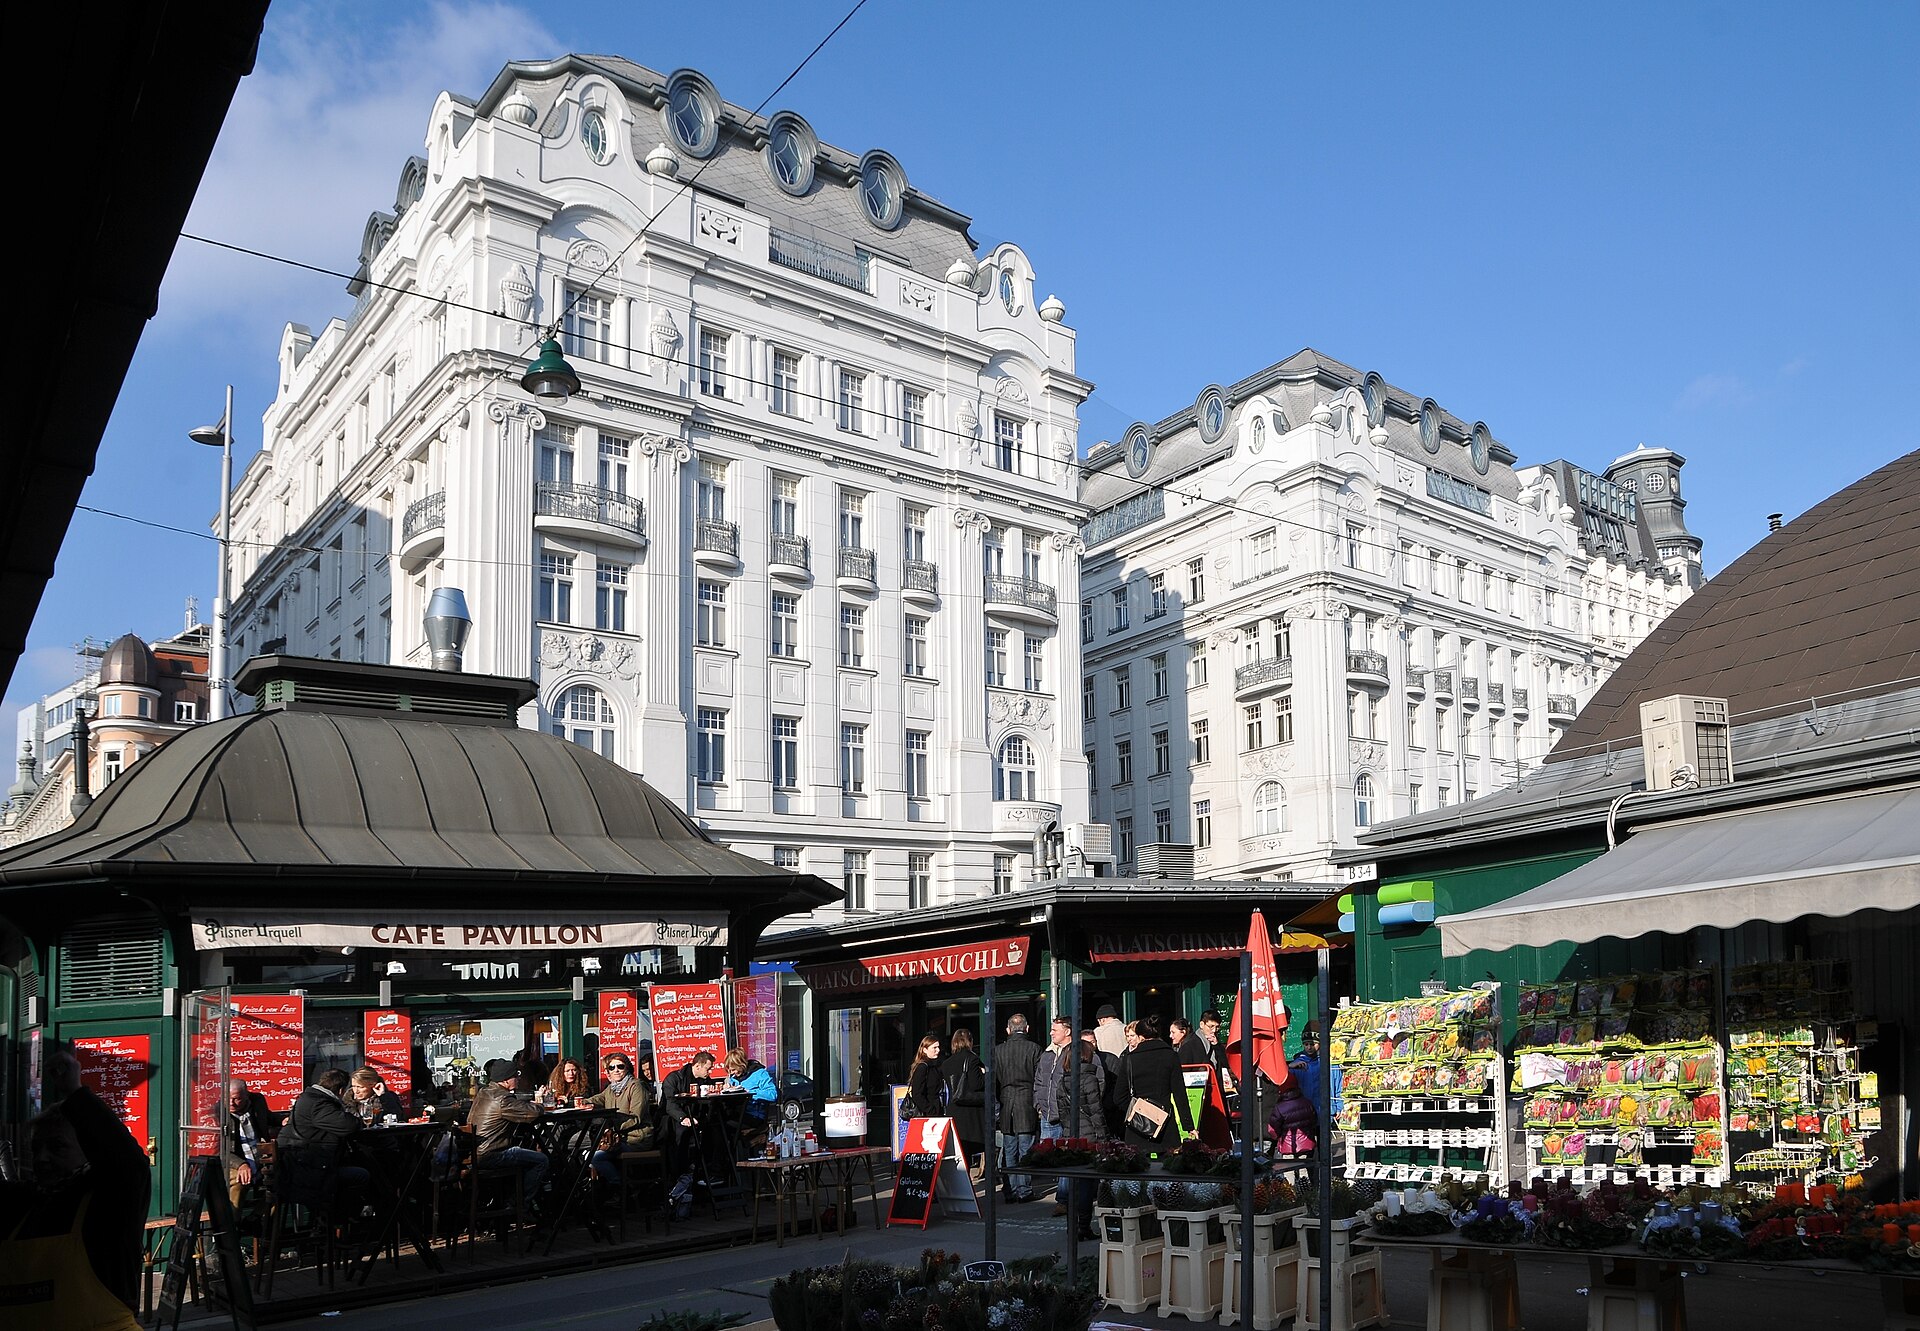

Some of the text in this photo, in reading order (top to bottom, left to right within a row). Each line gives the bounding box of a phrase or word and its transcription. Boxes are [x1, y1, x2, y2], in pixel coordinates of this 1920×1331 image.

[1350, 866, 1356, 880] B
[204, 918, 302, 943] Pilsner Urquell
[371, 923, 604, 945] CAFE PAVILLON
[656, 918, 690, 941] Pilsner
[802, 948, 1004, 991] ALATSCHINKENKUCHL
[429, 1032, 461, 1046] Heiße
